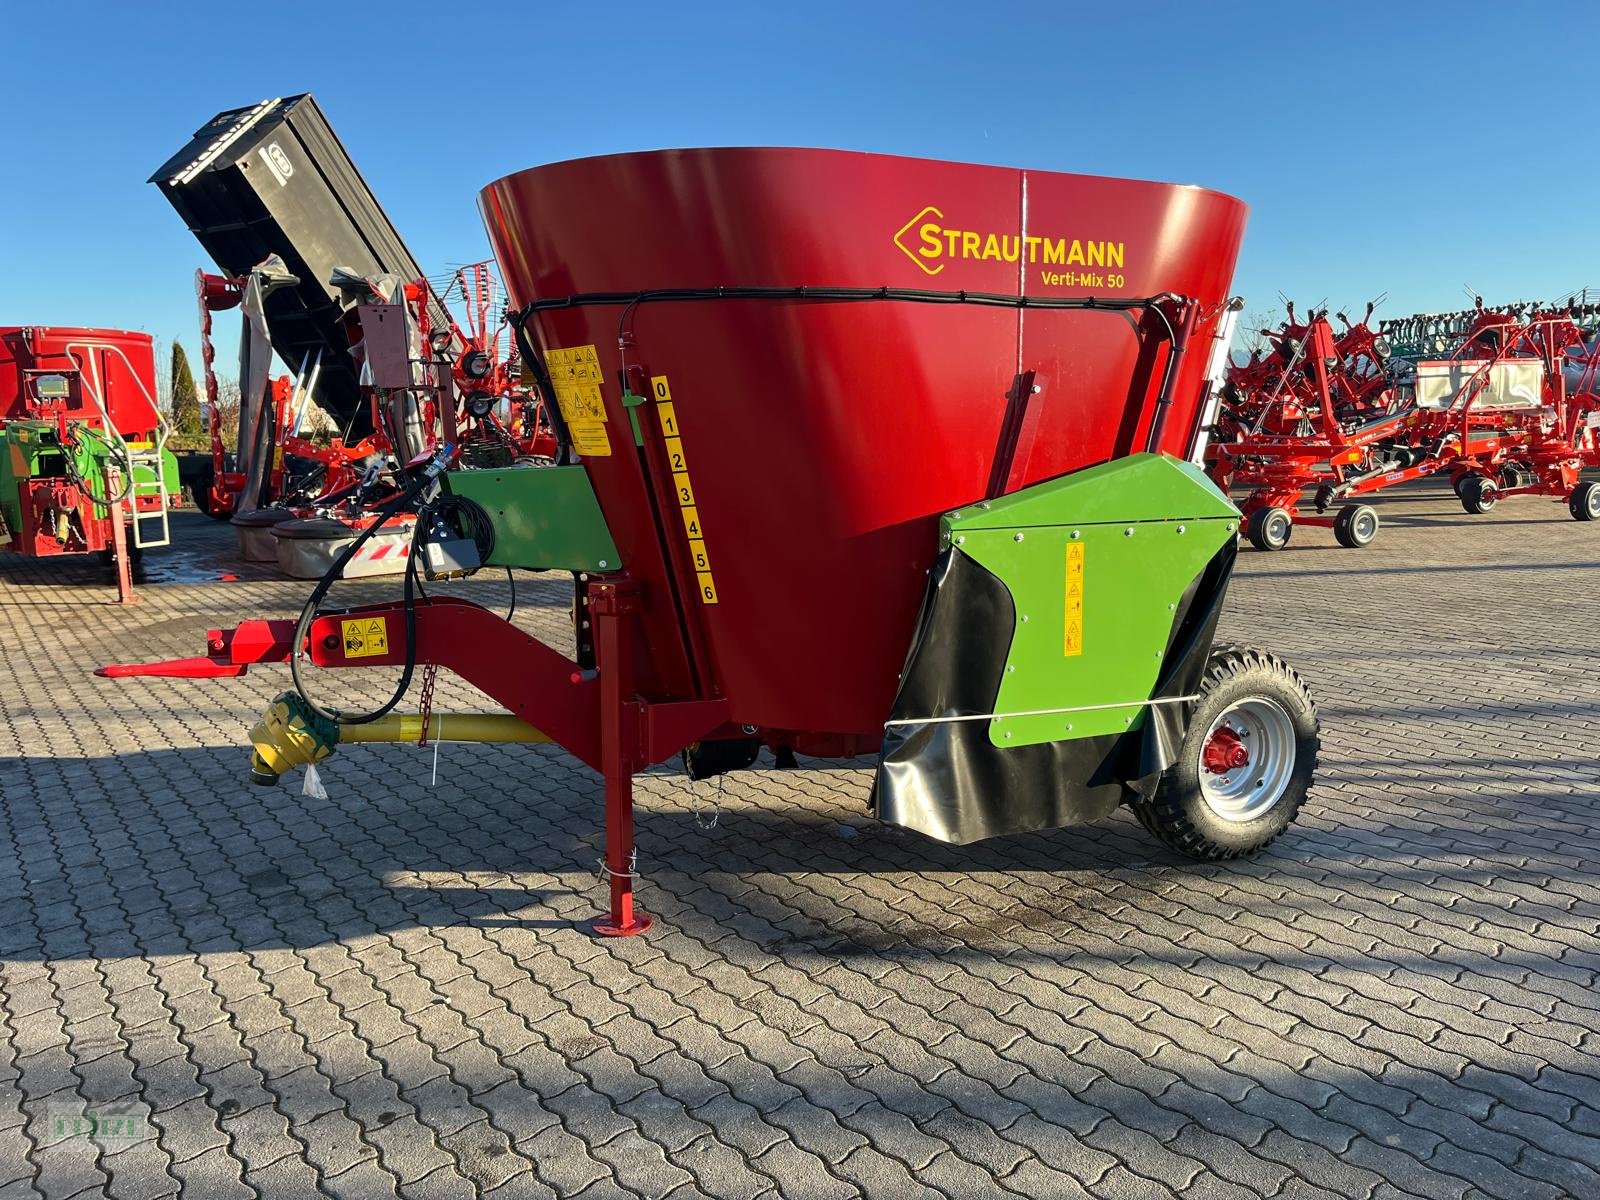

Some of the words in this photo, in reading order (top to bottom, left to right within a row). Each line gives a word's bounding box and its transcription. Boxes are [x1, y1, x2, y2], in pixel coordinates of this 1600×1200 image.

[918, 223, 1124, 268] STRAUTMANN
[1041, 271, 1103, 287] Verti-Mix
[1107, 274, 1124, 289] 50
[656, 382, 666, 397] 0
[665, 417, 674, 433] 1
[673, 453, 683, 469] 2
[681, 487, 691, 502] 3
[689, 520, 699, 535] 4
[697, 553, 706, 568] 5
[704, 585, 713, 600] 6
